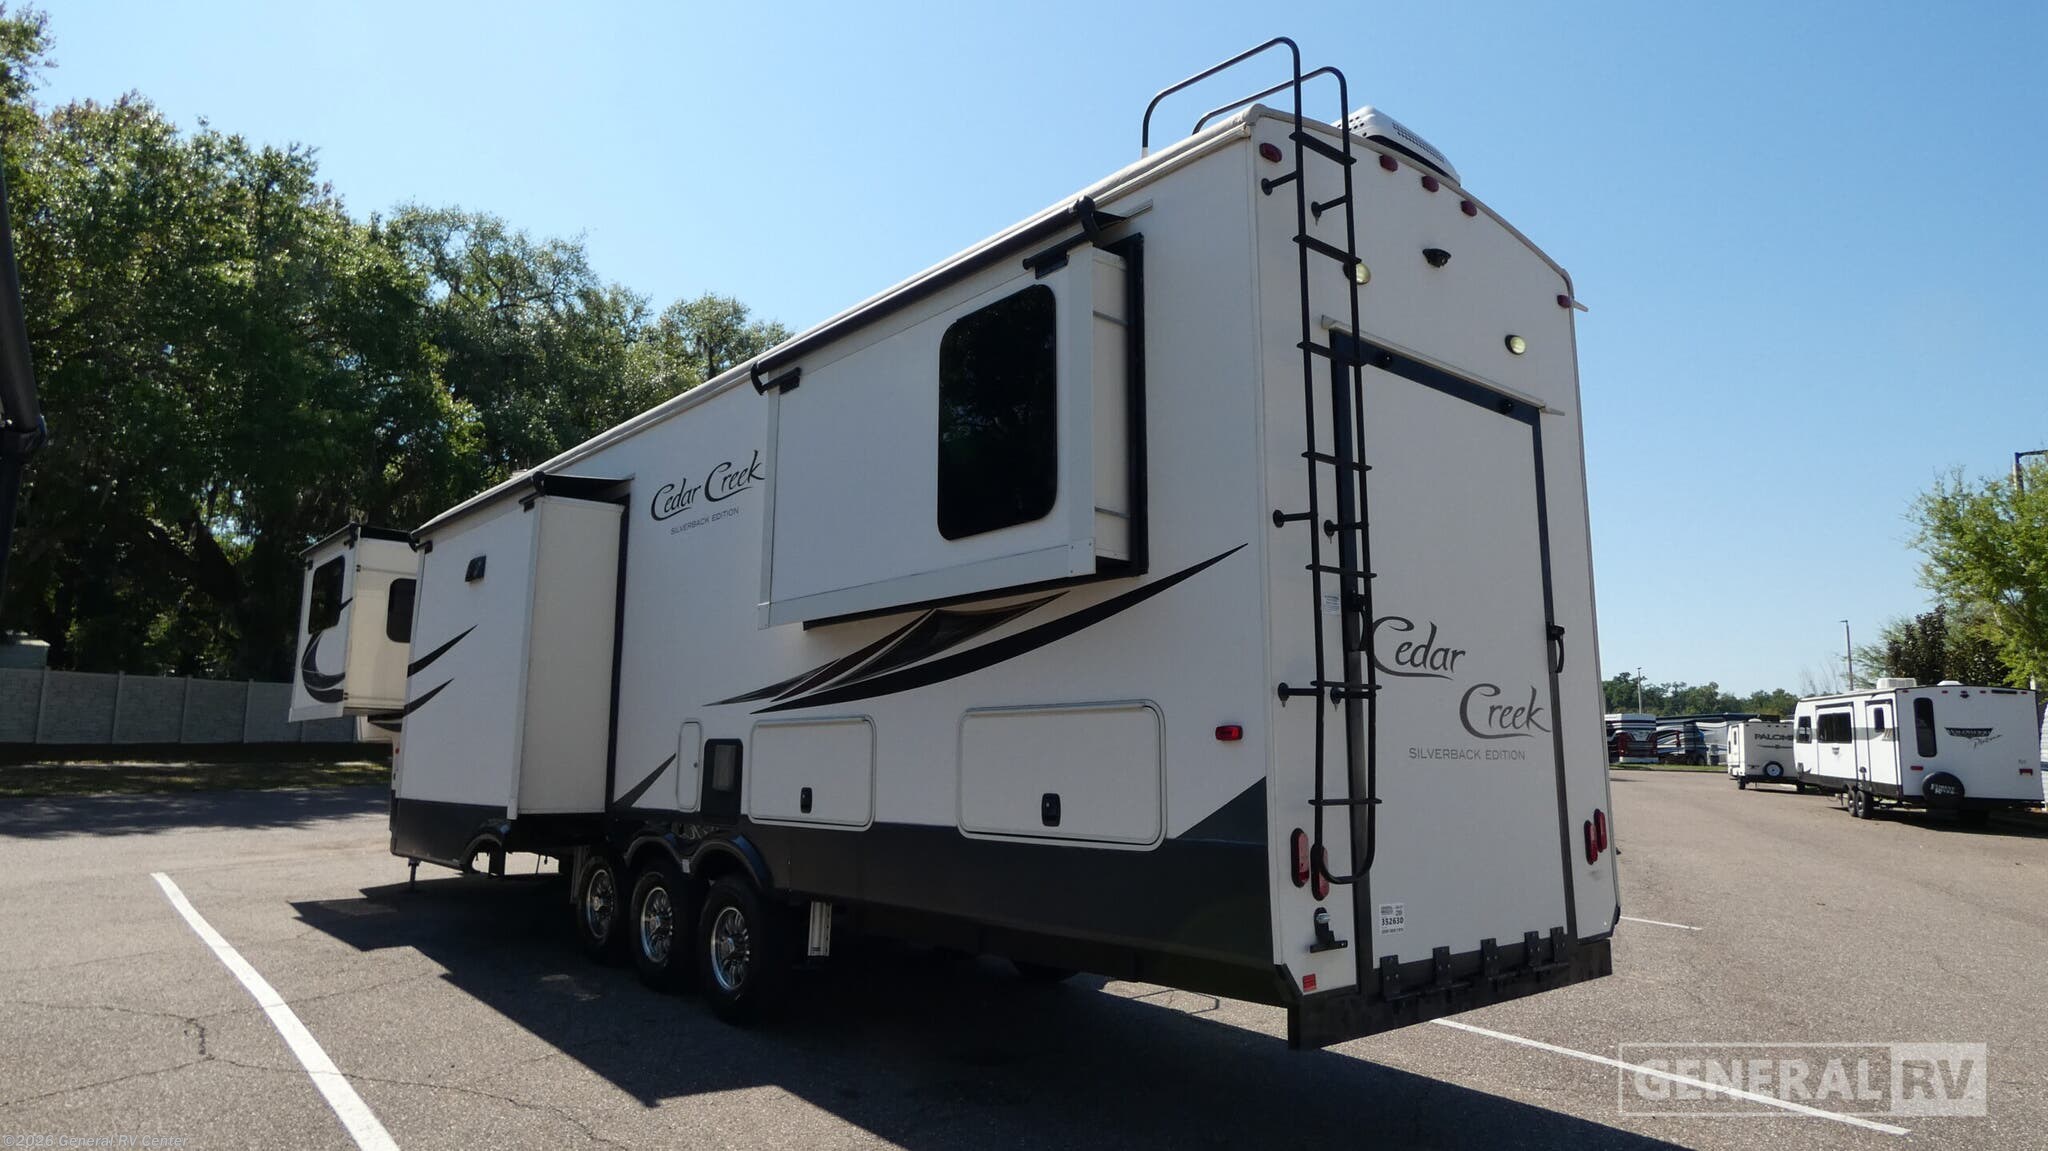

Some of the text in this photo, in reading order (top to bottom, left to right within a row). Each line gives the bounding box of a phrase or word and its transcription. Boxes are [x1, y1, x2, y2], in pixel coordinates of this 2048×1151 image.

[651, 449, 766, 521] Cedar Creek
[670, 507, 740, 535] SILVERBACK EDITION
[1371, 615, 1466, 681] Cedar
[1459, 682, 1552, 740] Creek
[1408, 747, 1526, 761] SILVERBACK EDITION
